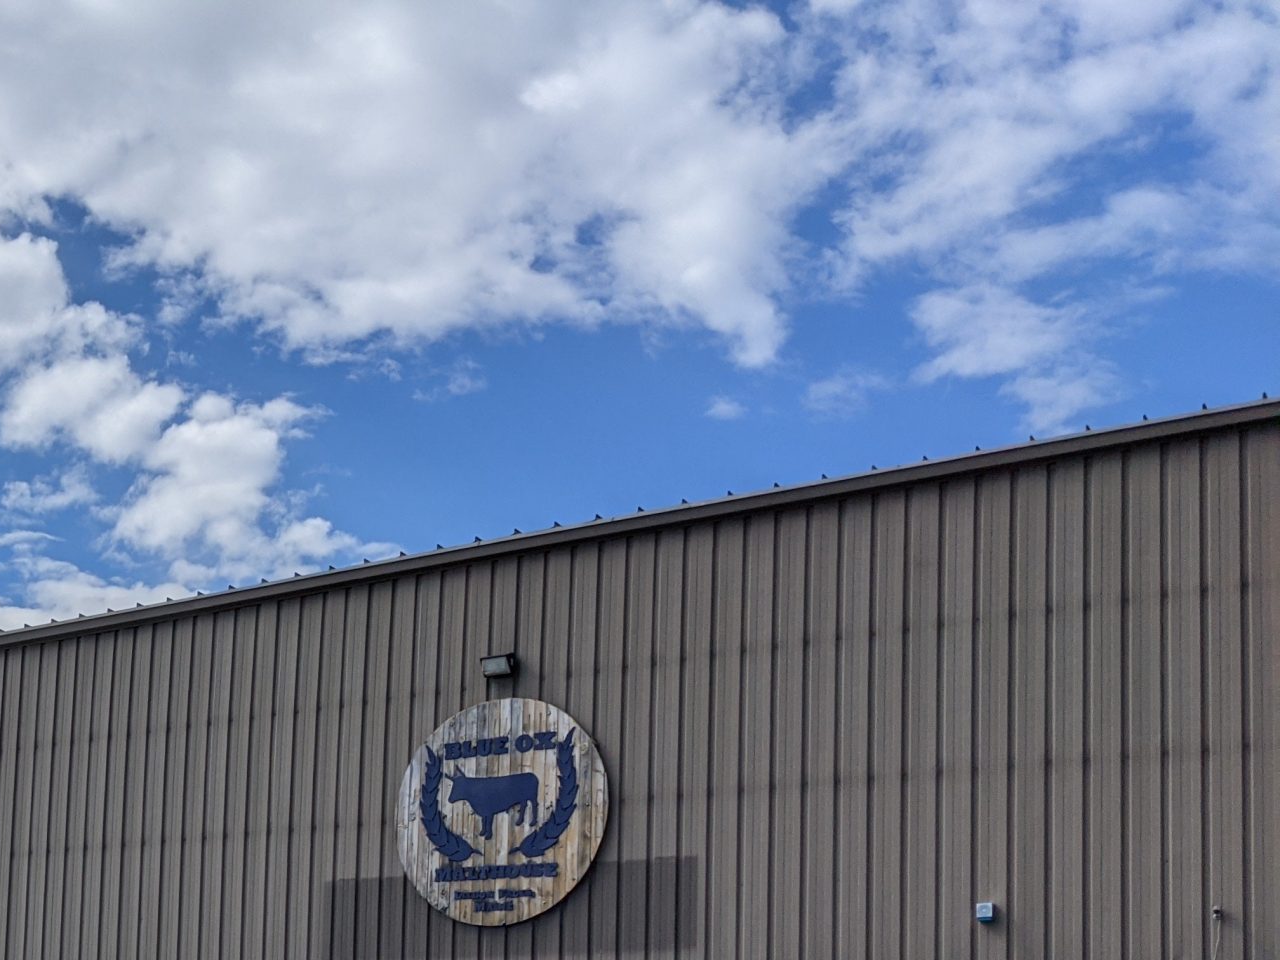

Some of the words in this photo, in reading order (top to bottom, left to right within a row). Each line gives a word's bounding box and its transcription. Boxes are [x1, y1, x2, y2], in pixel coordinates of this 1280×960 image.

[444, 736, 509, 760] BLUE
[515, 731, 557, 753] OX
[434, 863, 559, 882] MALTHOUSE
